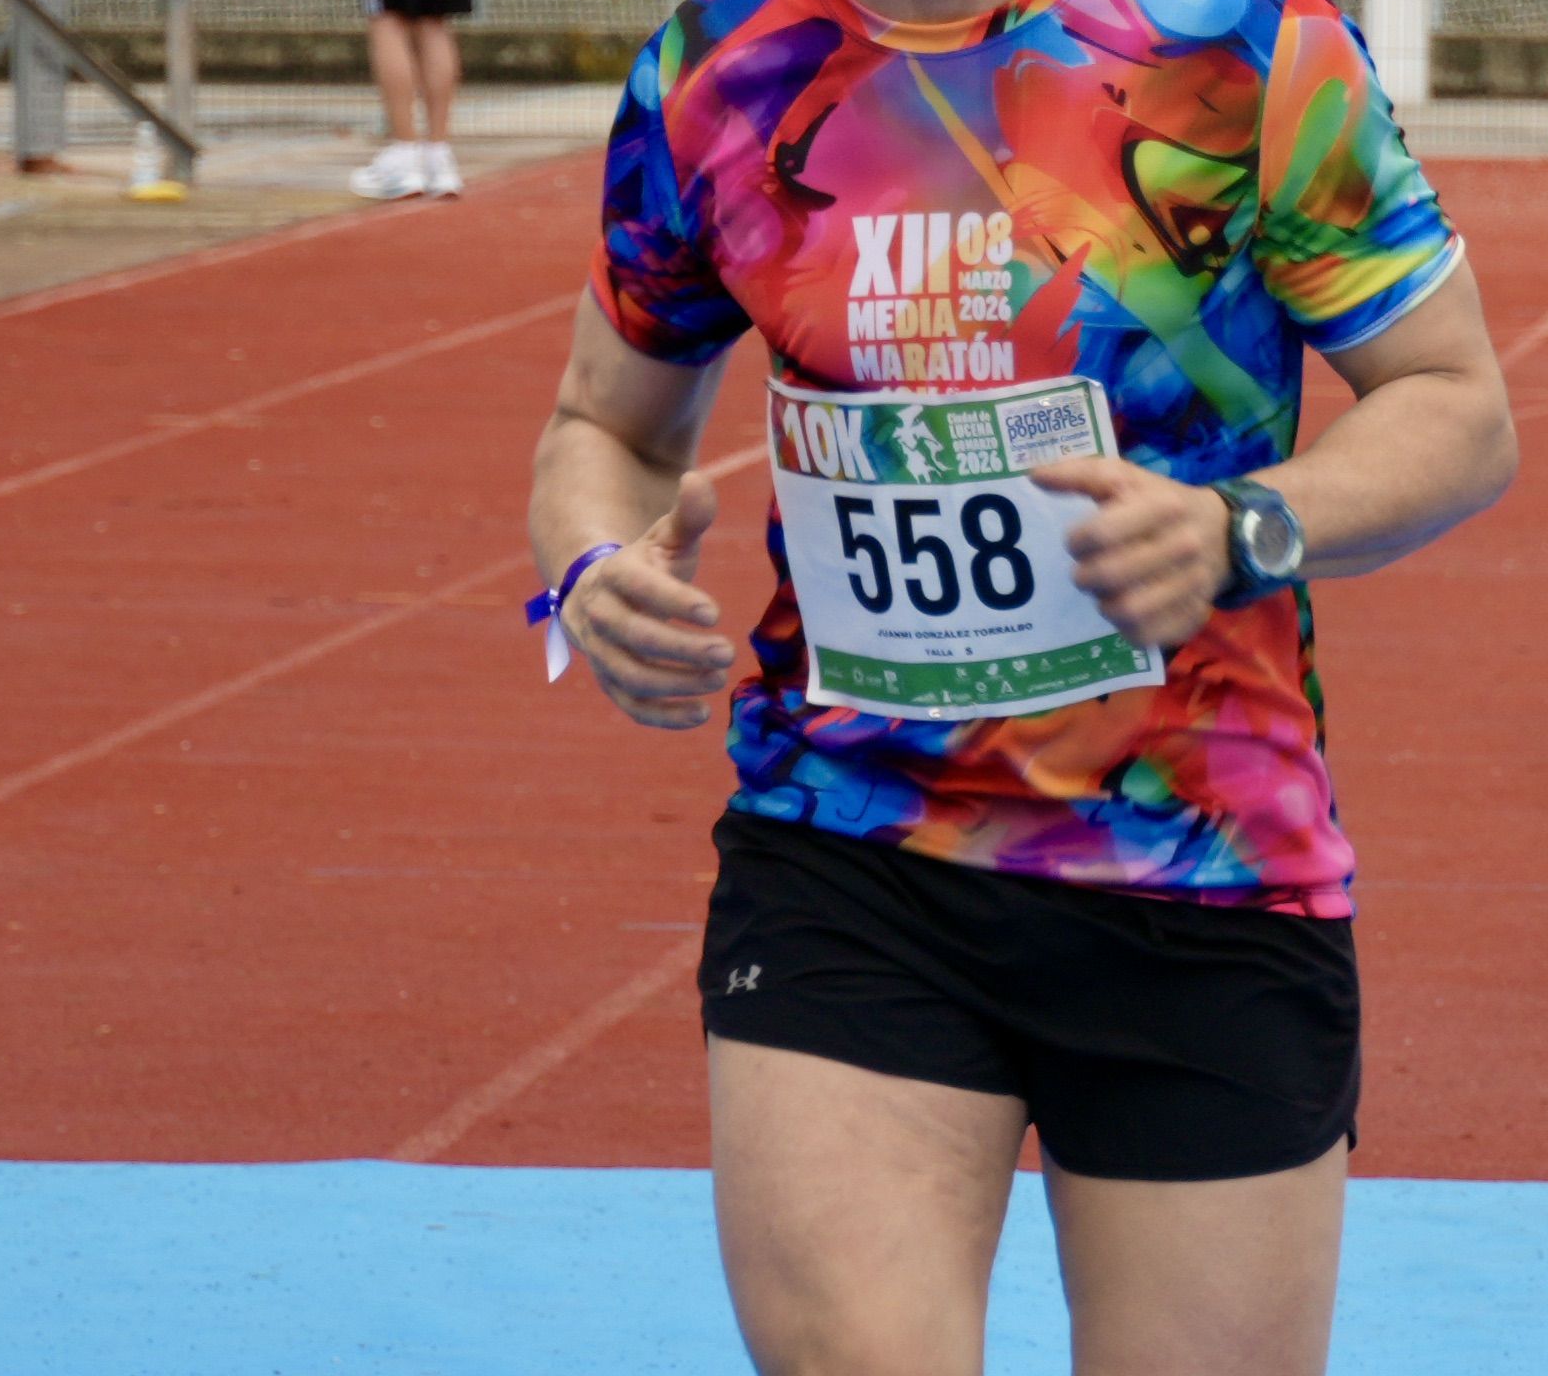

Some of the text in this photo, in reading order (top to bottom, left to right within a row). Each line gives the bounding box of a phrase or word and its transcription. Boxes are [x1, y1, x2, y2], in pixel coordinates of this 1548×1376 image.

[848, 212, 951, 298] XII
[956, 211, 1014, 266] 08
[958, 270, 1012, 290] MARZO
[848, 298, 957, 342] MEDIA
[959, 294, 1013, 322] 2026
[850, 331, 1015, 382] MARATÓN
[1005, 405, 1072, 428] carreras
[1008, 413, 1086, 444] populares
[783, 402, 876, 481] 10K
[956, 450, 1003, 476] 2026
[829, 493, 1035, 617] 558
